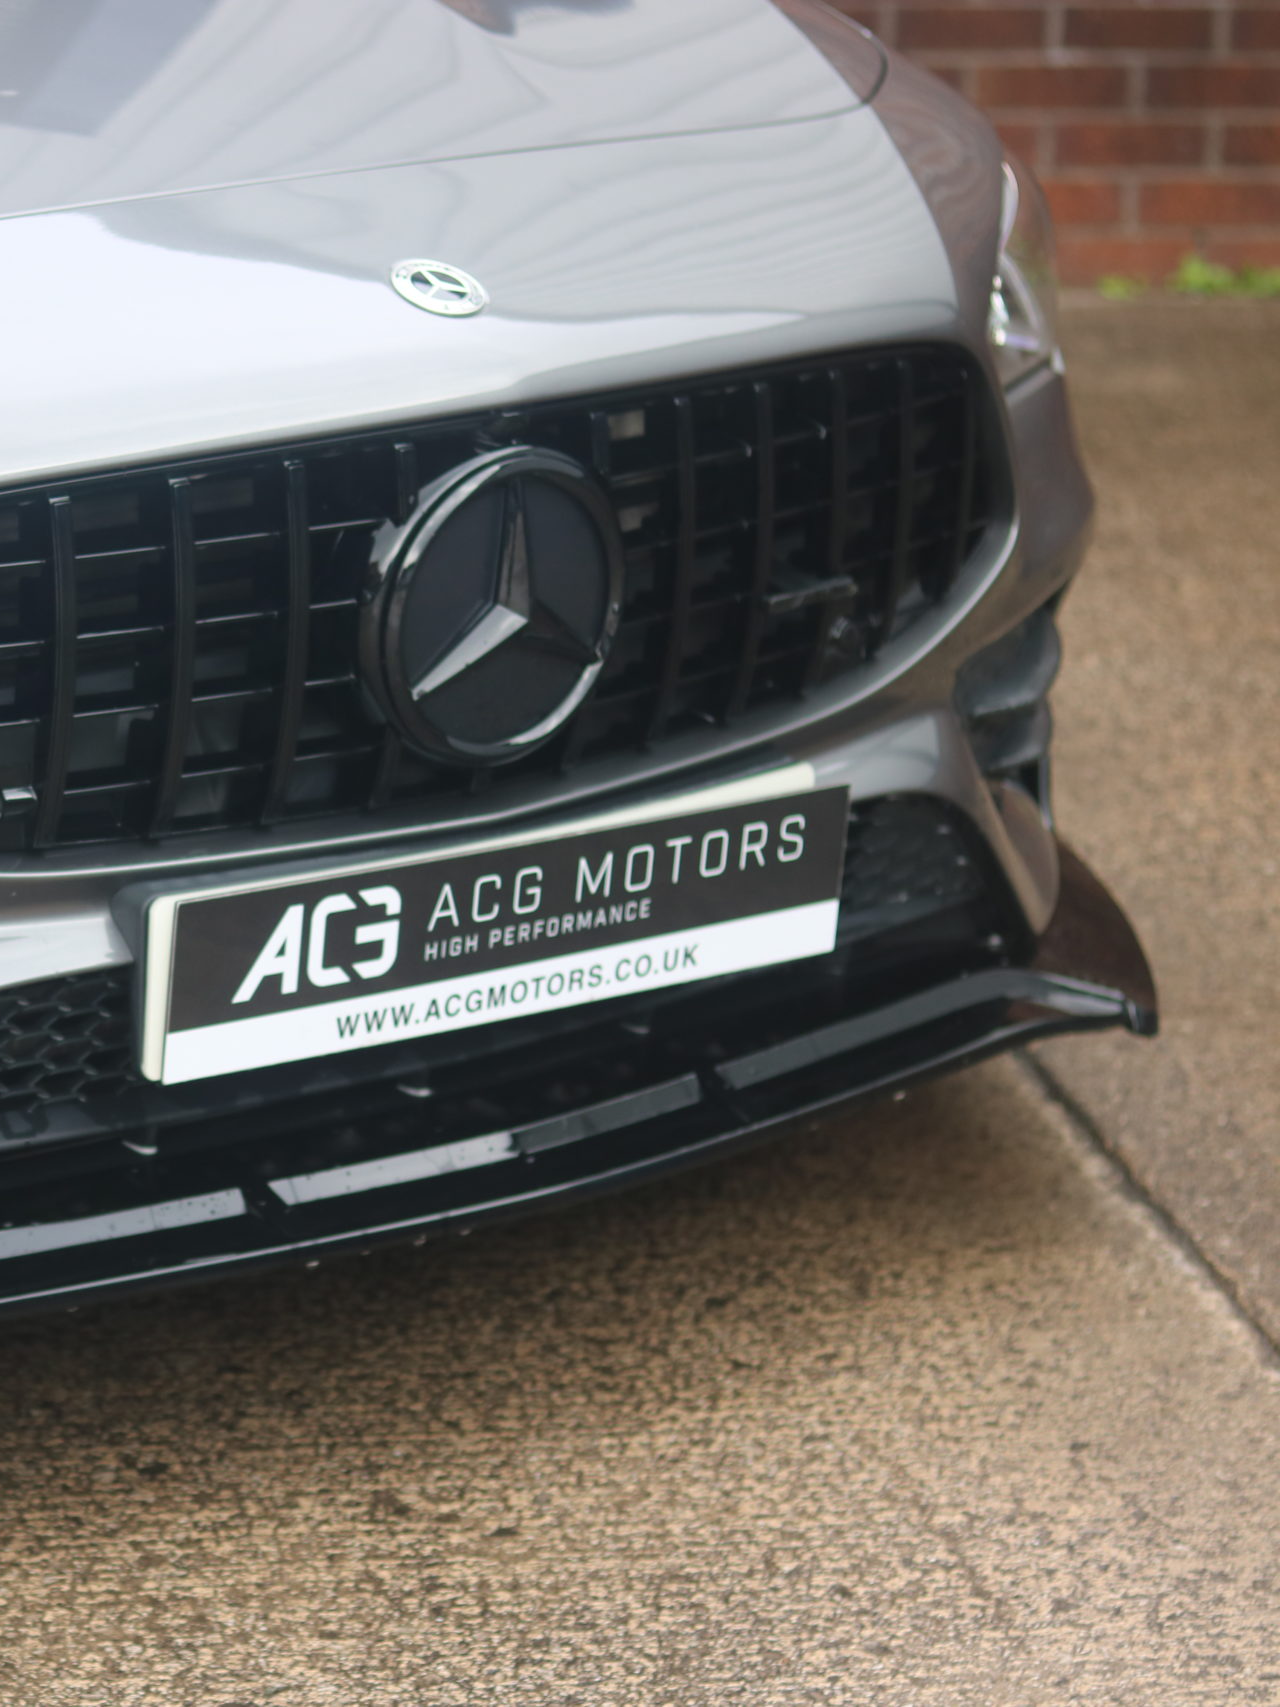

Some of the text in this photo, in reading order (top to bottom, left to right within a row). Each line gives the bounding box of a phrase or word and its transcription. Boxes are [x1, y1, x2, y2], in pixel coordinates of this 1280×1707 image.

[427, 813, 807, 932] ACG MOTORS
[424, 898, 652, 962] HIGH PERFORMANCE
[335, 943, 700, 1040] WWW.ACGMOTORS.CO.UK
